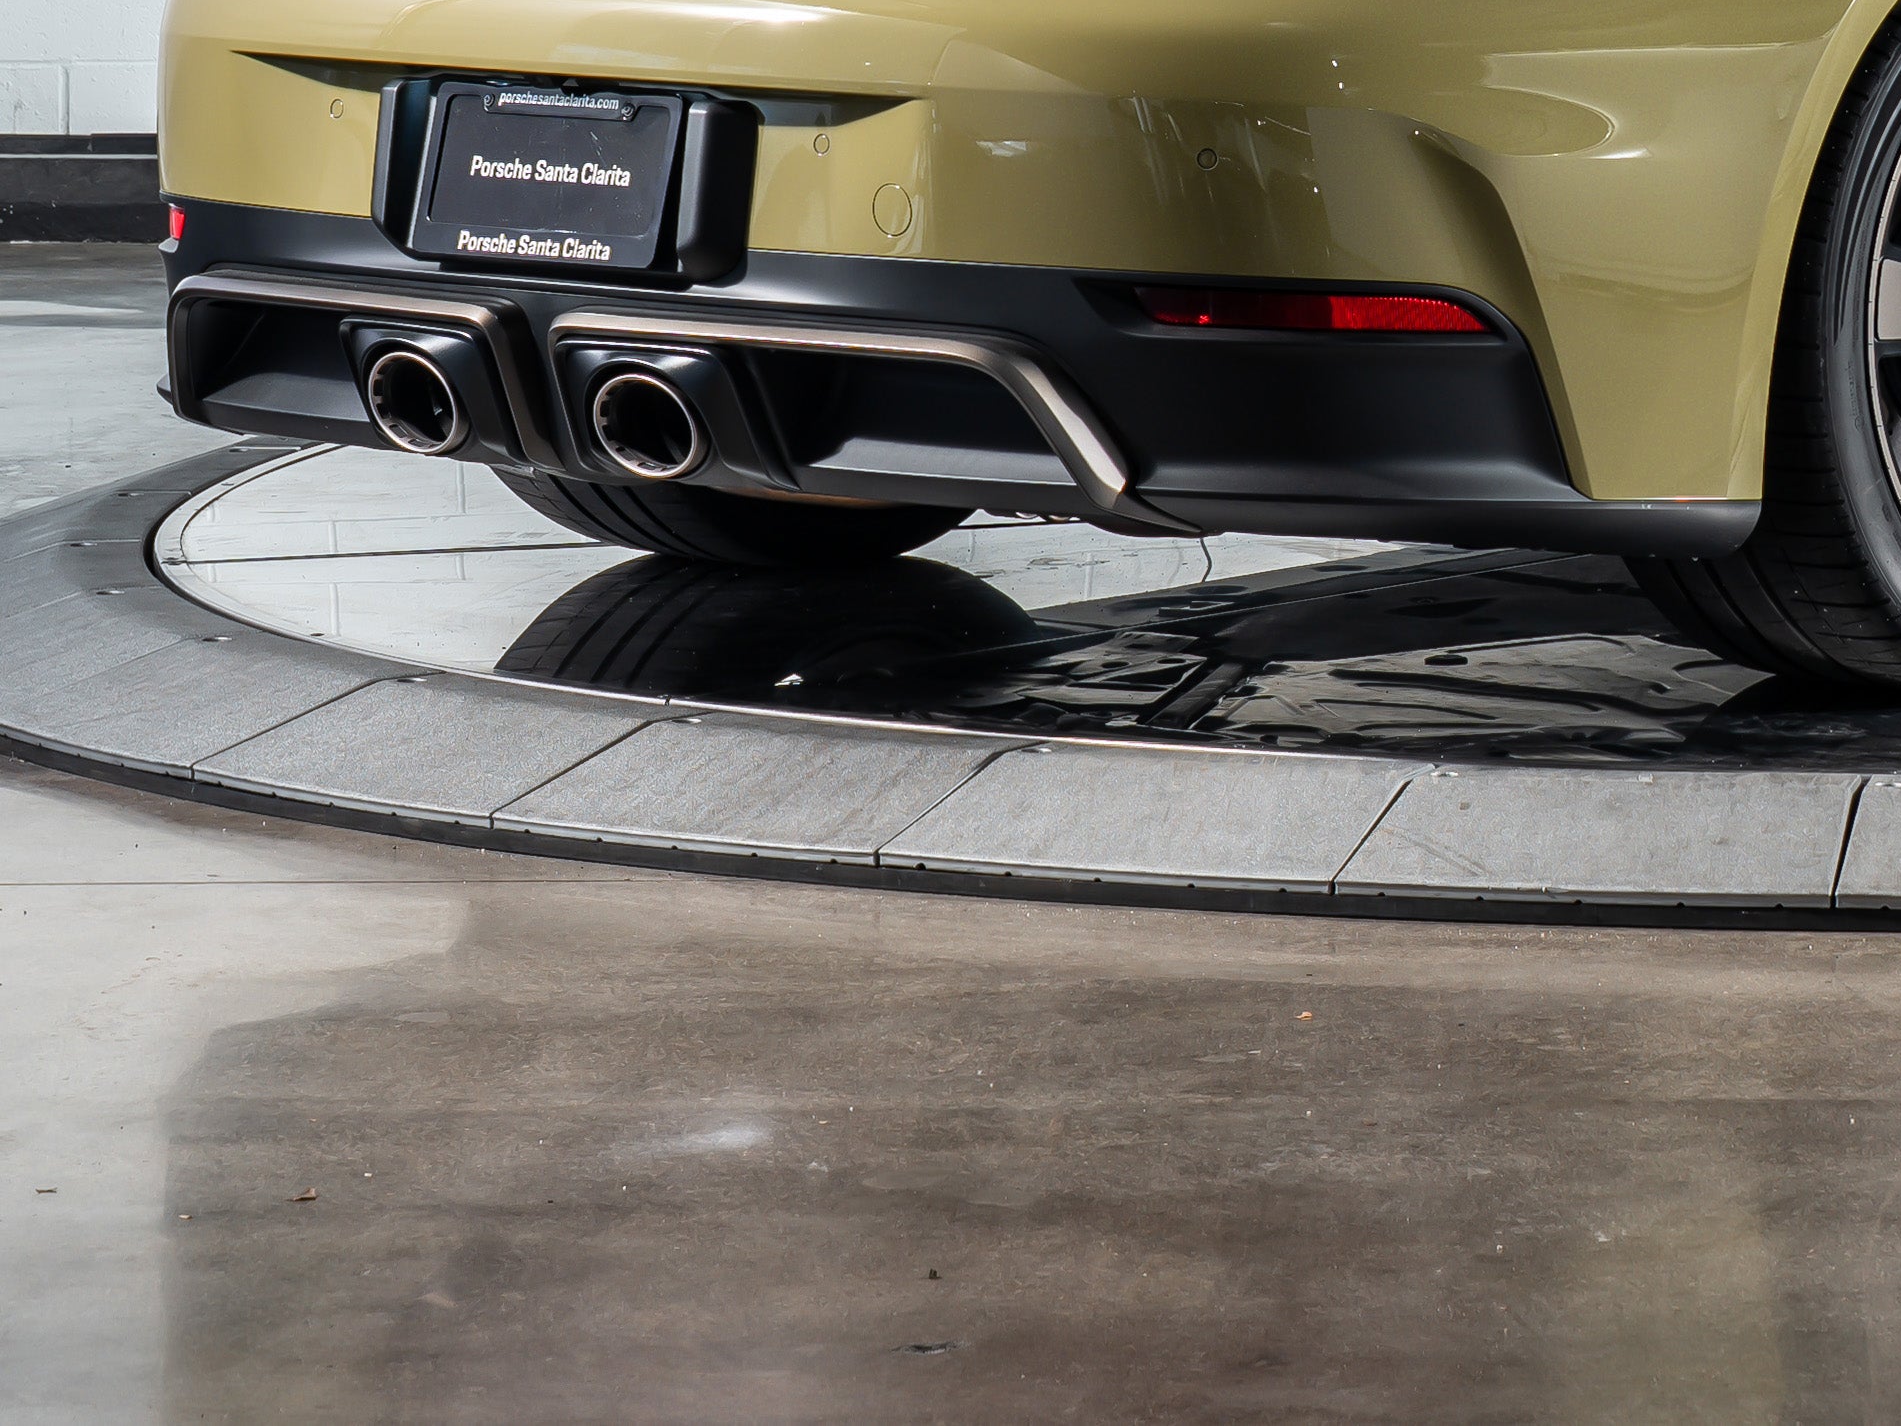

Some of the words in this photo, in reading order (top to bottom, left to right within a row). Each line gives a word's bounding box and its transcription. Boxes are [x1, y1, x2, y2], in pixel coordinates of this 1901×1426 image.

[498, 91, 620, 111] porschesantaclarita.com
[470, 155, 533, 180] Porsche
[534, 159, 579, 184] Santa
[581, 162, 631, 187] Clarita
[457, 230, 517, 255] Porsche
[517, 234, 561, 258] Santa
[562, 238, 612, 261] Clarita
